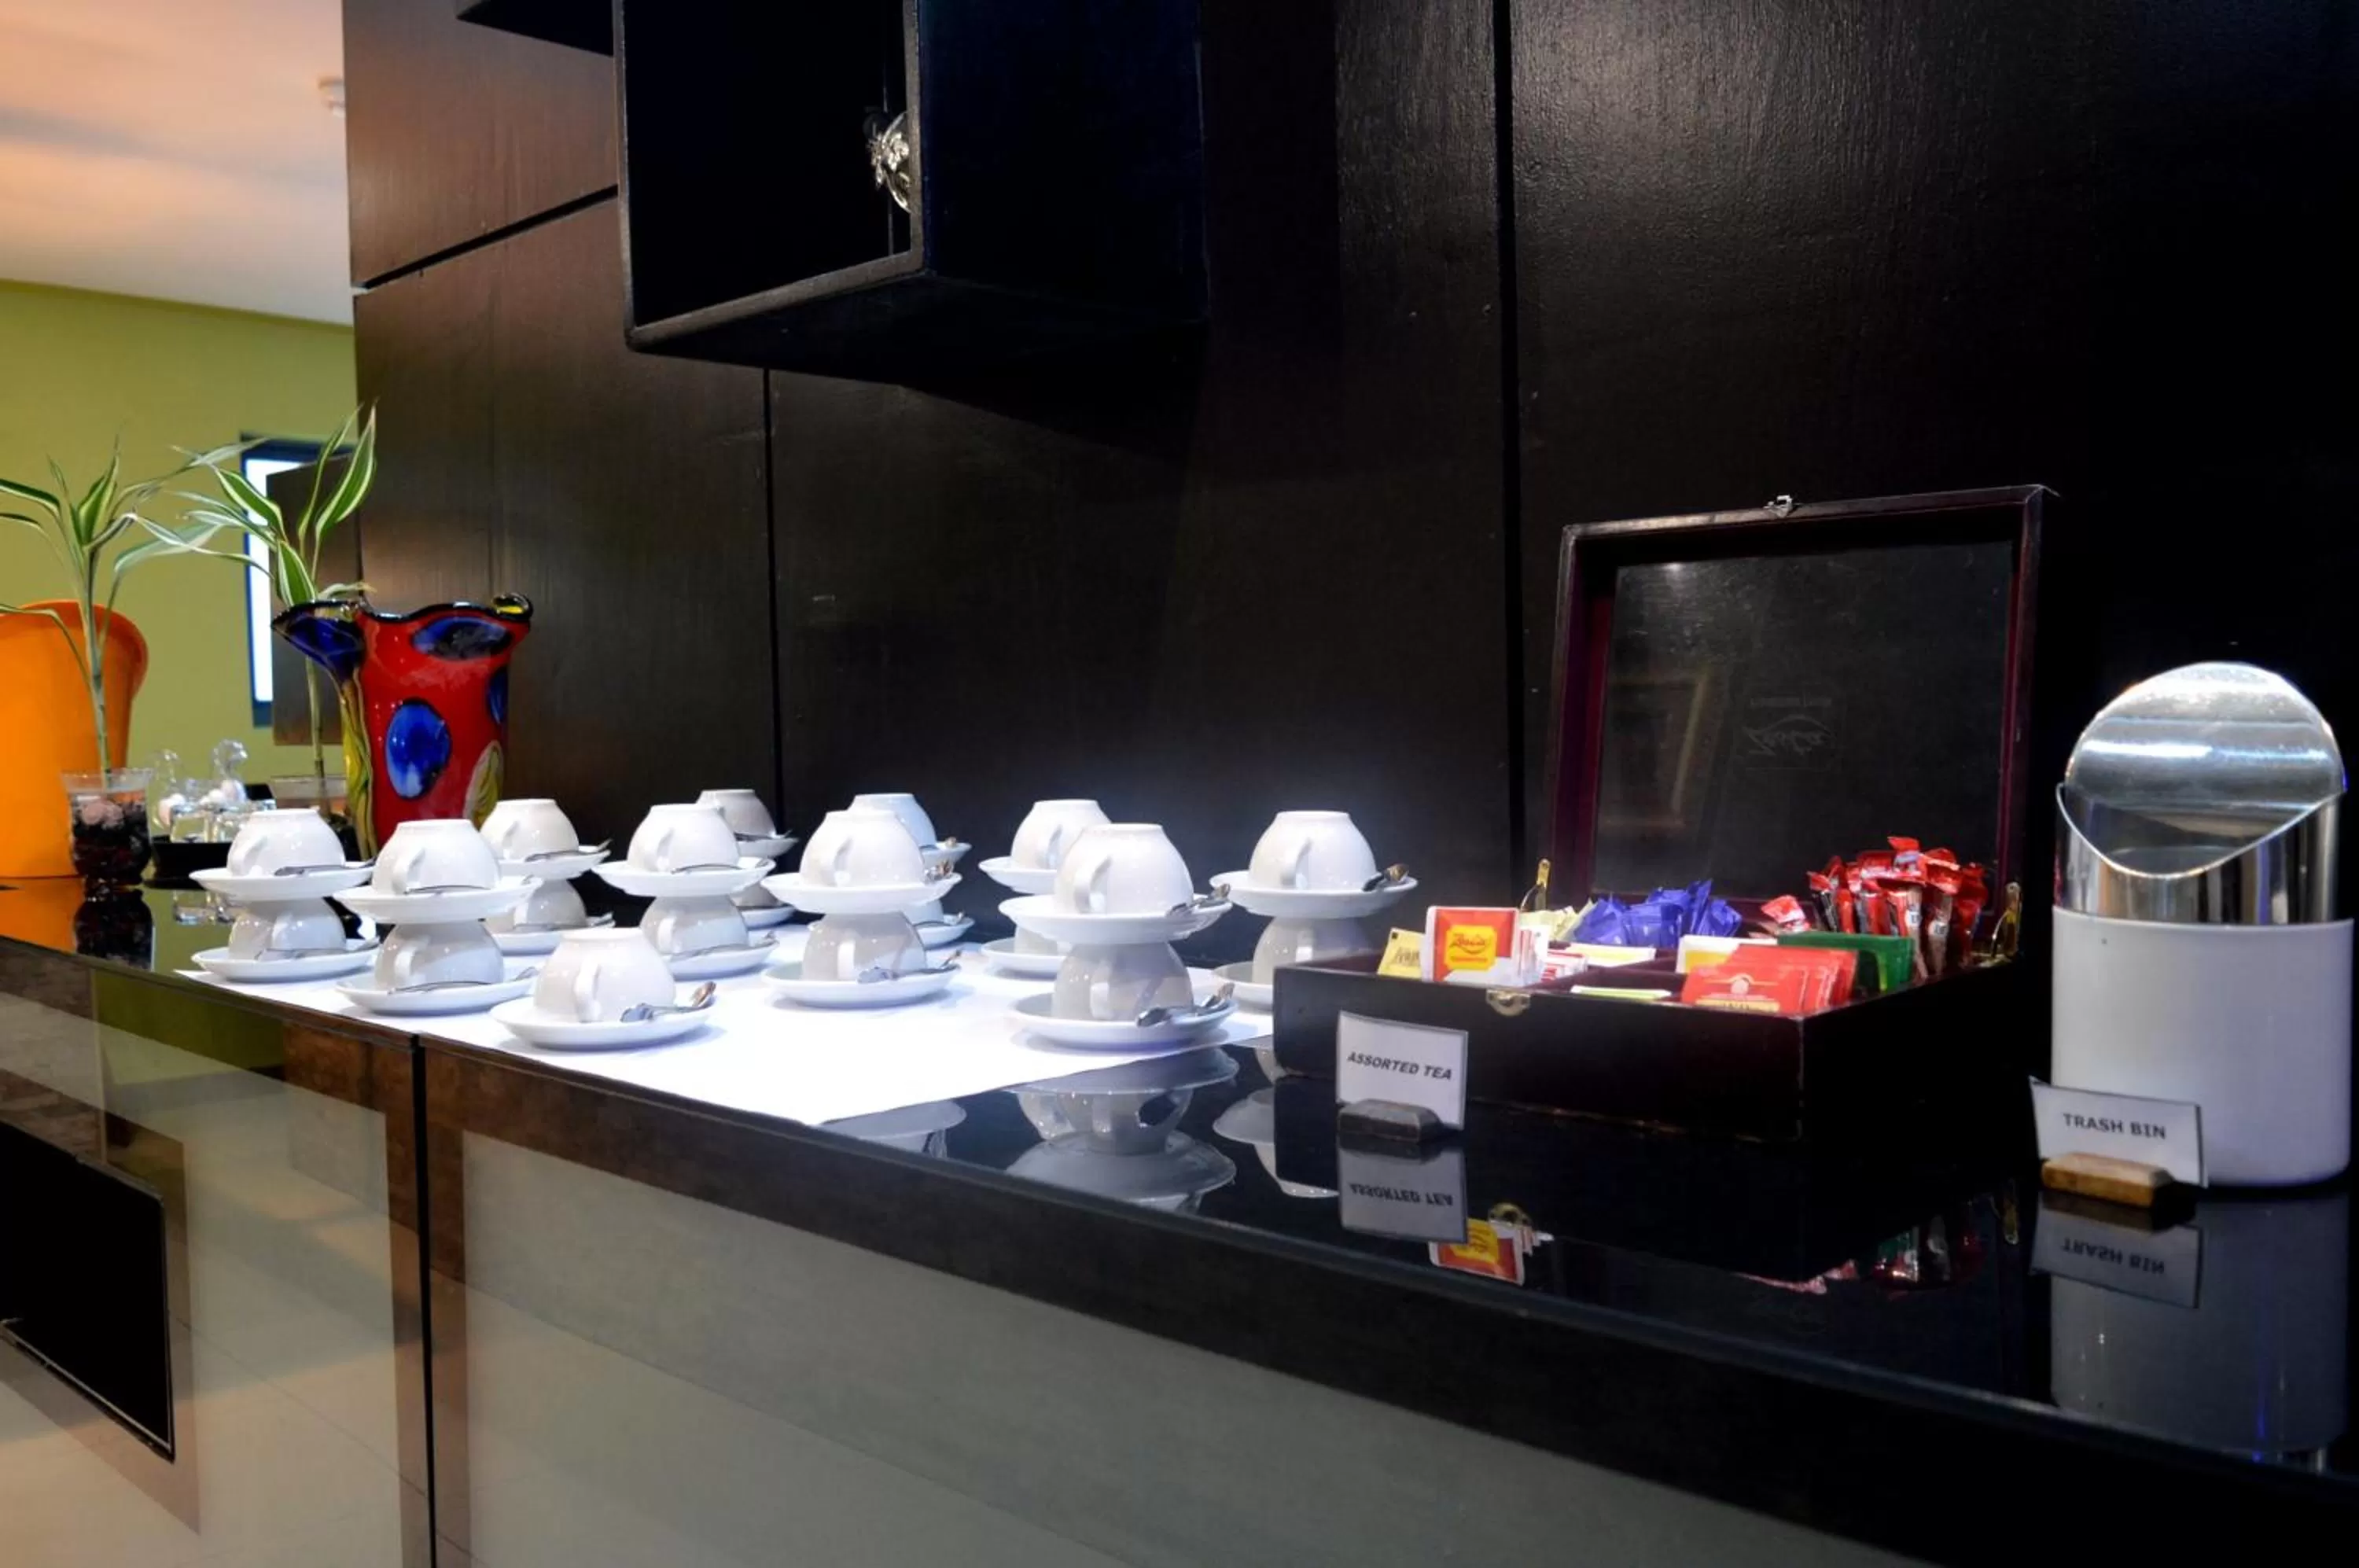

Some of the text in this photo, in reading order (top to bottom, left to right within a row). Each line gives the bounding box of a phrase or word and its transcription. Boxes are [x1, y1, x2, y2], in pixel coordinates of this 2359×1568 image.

[1347, 1051, 1452, 1080] ASSORTED TEA
[2063, 1113, 2166, 1139] TRASH BIN
